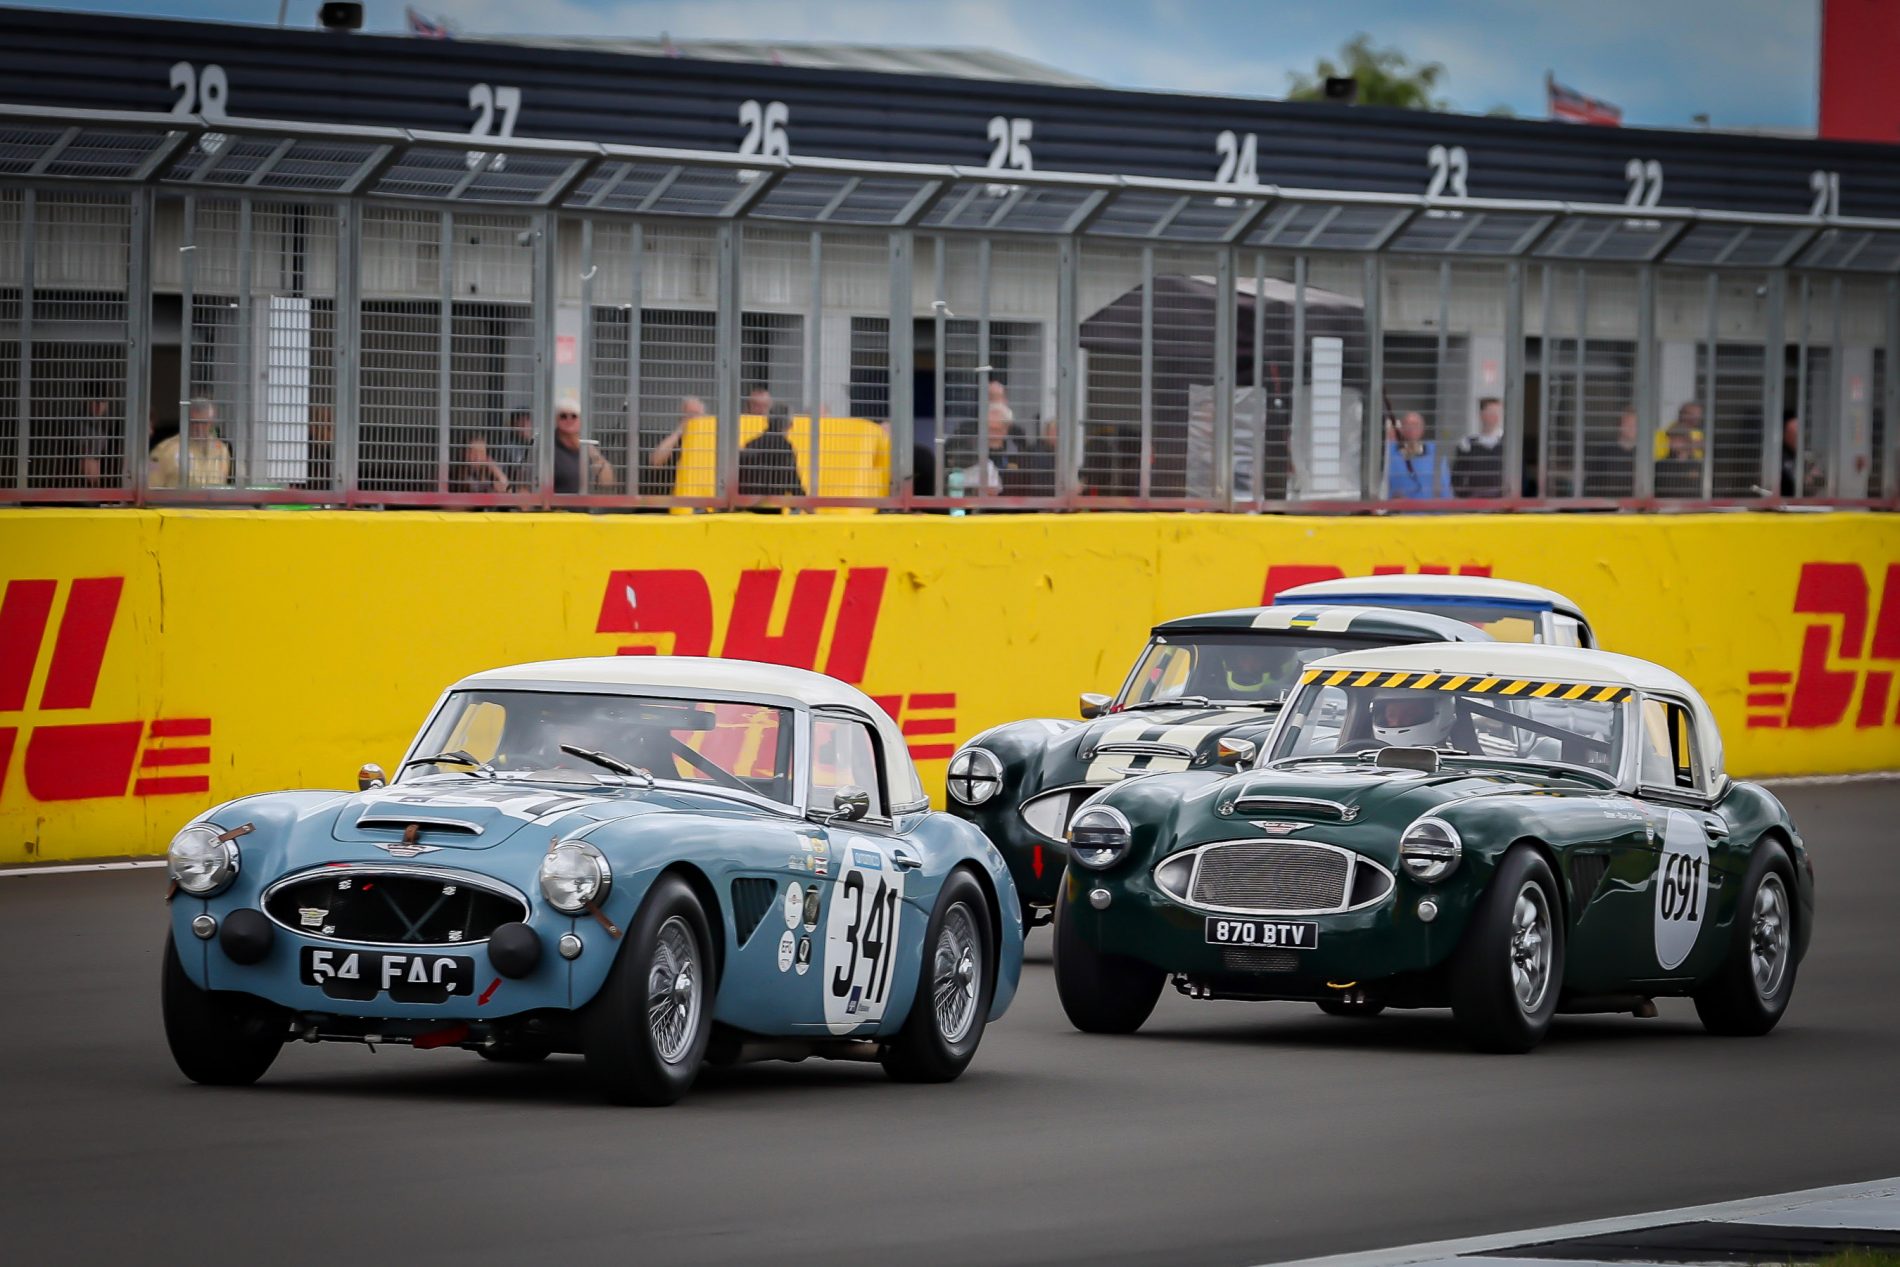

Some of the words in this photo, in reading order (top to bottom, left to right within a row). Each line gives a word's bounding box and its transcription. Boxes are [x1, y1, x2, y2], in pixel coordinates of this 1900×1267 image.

[467, 83, 521, 171] 27
[738, 99, 790, 183] 26
[986, 115, 1033, 197] 25
[1215, 129, 1260, 207] 24
[1426, 144, 1468, 218] 23
[1625, 158, 1664, 228] 22
[1810, 170, 1840, 236] 21
[1661, 853, 1702, 921] 691
[832, 870, 897, 1003] 341
[1217, 921, 1256, 942] 870
[1263, 923, 1305, 945] BTV
[312, 950, 361, 984] 54
[381, 955, 458, 992] FAC
